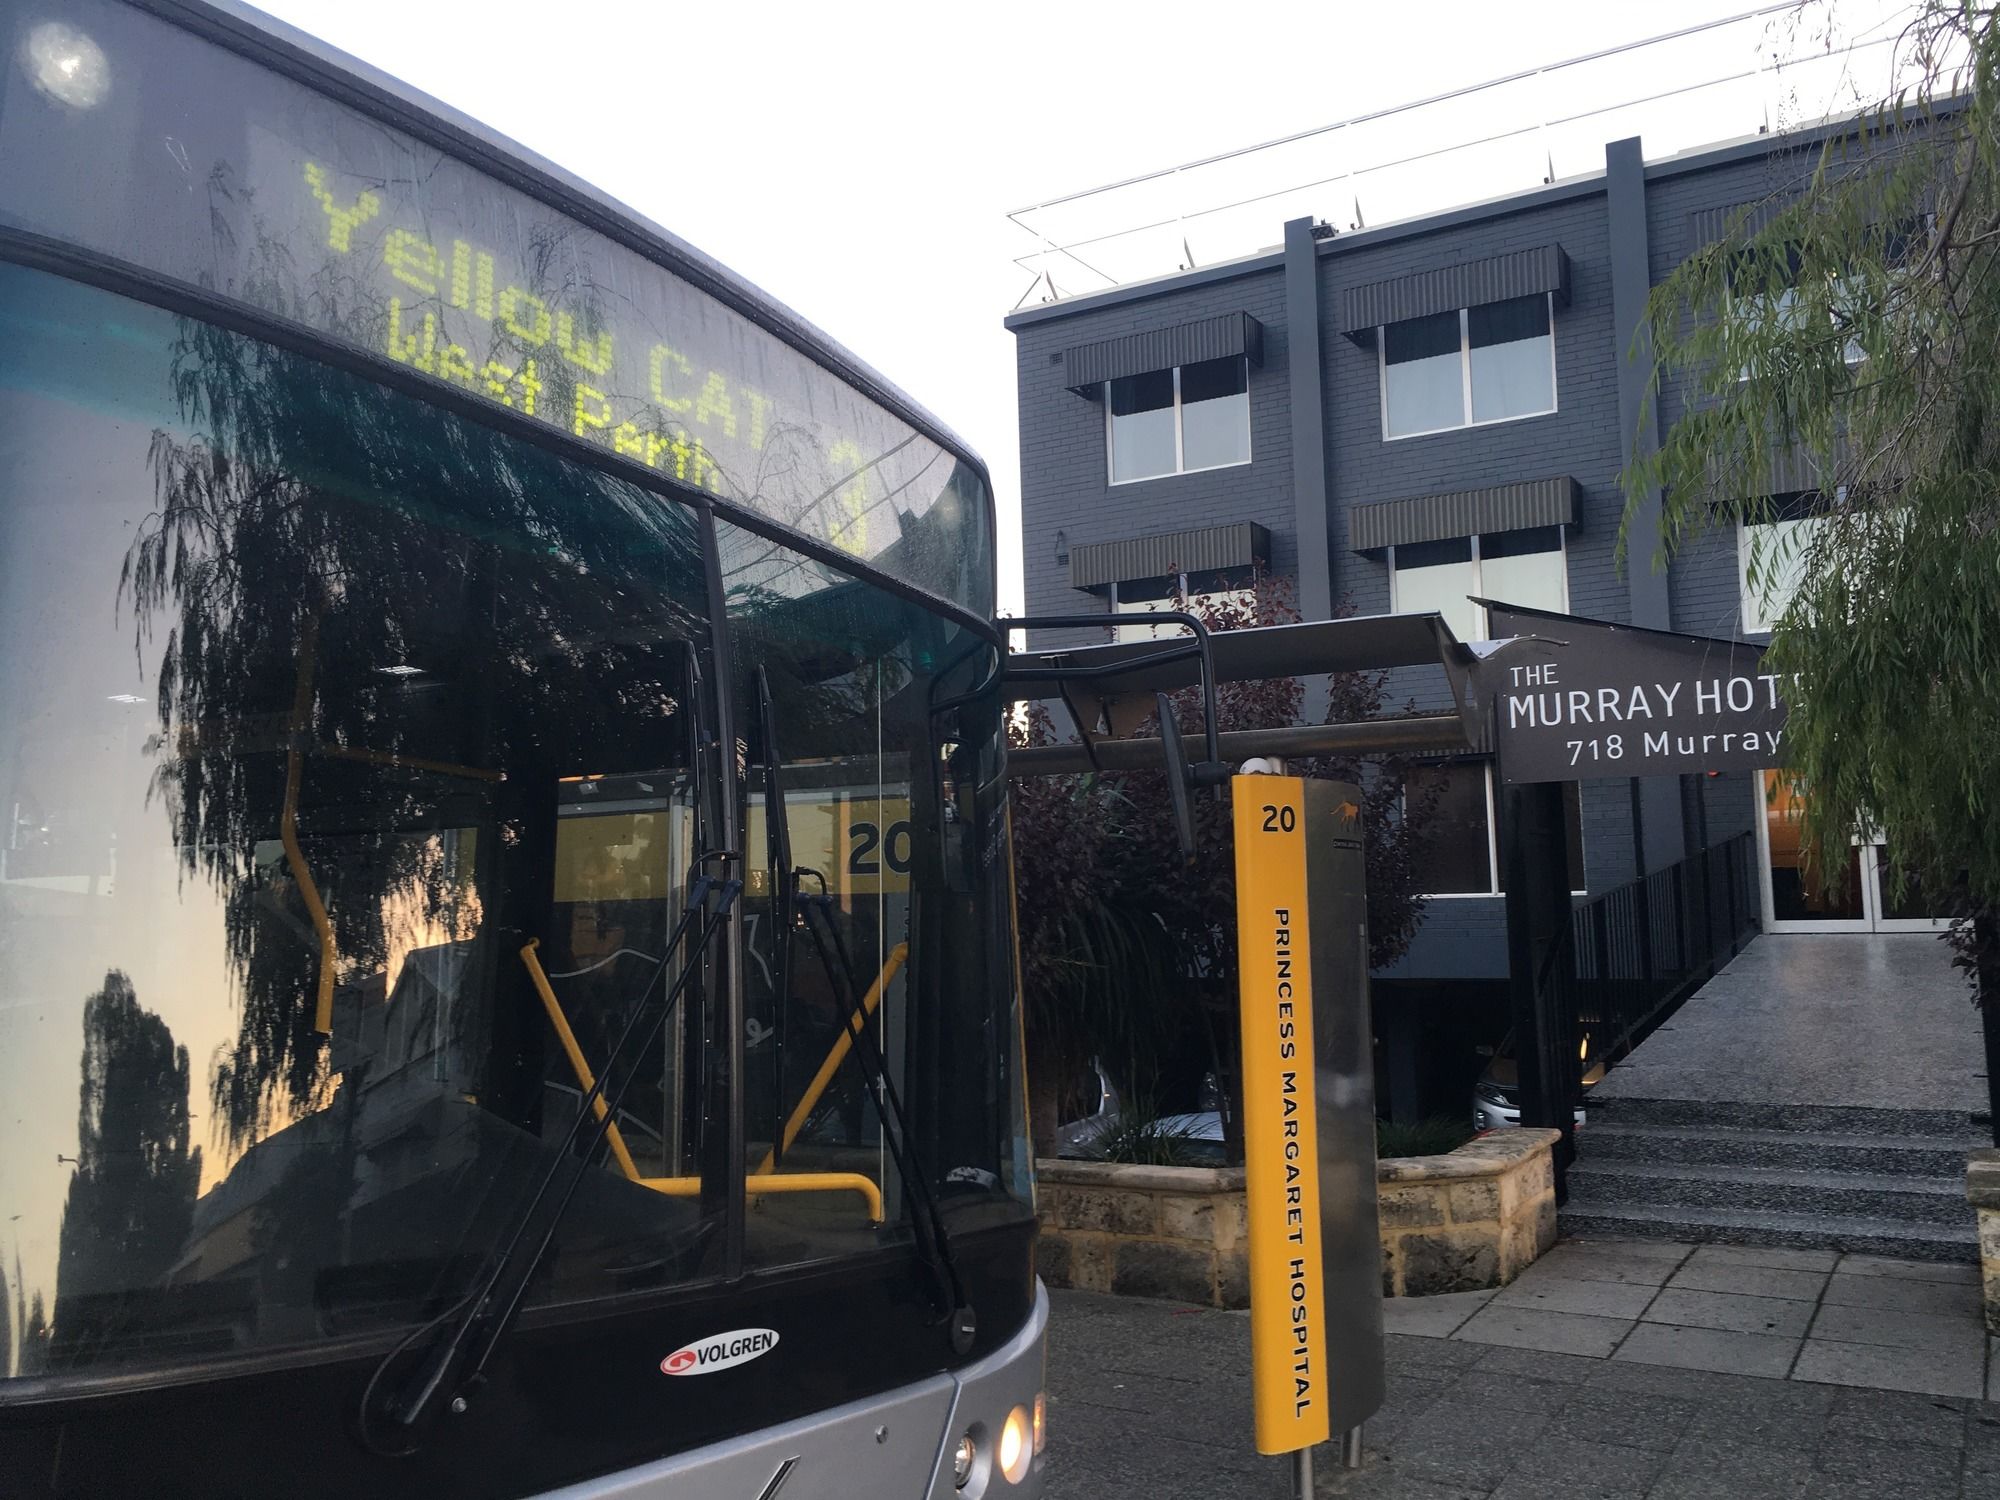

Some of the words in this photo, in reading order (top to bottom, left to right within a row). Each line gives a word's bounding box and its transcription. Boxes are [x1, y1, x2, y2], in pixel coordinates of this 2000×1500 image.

[305, 163, 613, 375] Yellow
[650, 344, 772, 451] CAT
[387, 296, 541, 415] West
[574, 382, 720, 494] Perth
[1509, 682, 1682, 729] MURRAY
[1695, 672, 1813, 715] HOT
[1510, 663, 1560, 687] THE
[1567, 734, 1624, 766] 718
[1644, 731, 1782, 756] Murray
[848, 820, 911, 874] 20
[1262, 805, 1296, 832] 20
[1275, 909, 1295, 1060] PRINCESS
[1281, 1071, 1303, 1244] MARGARET
[697, 1332, 773, 1365] VOLGREN
[1289, 1258, 1312, 1417] HOSPITAL
